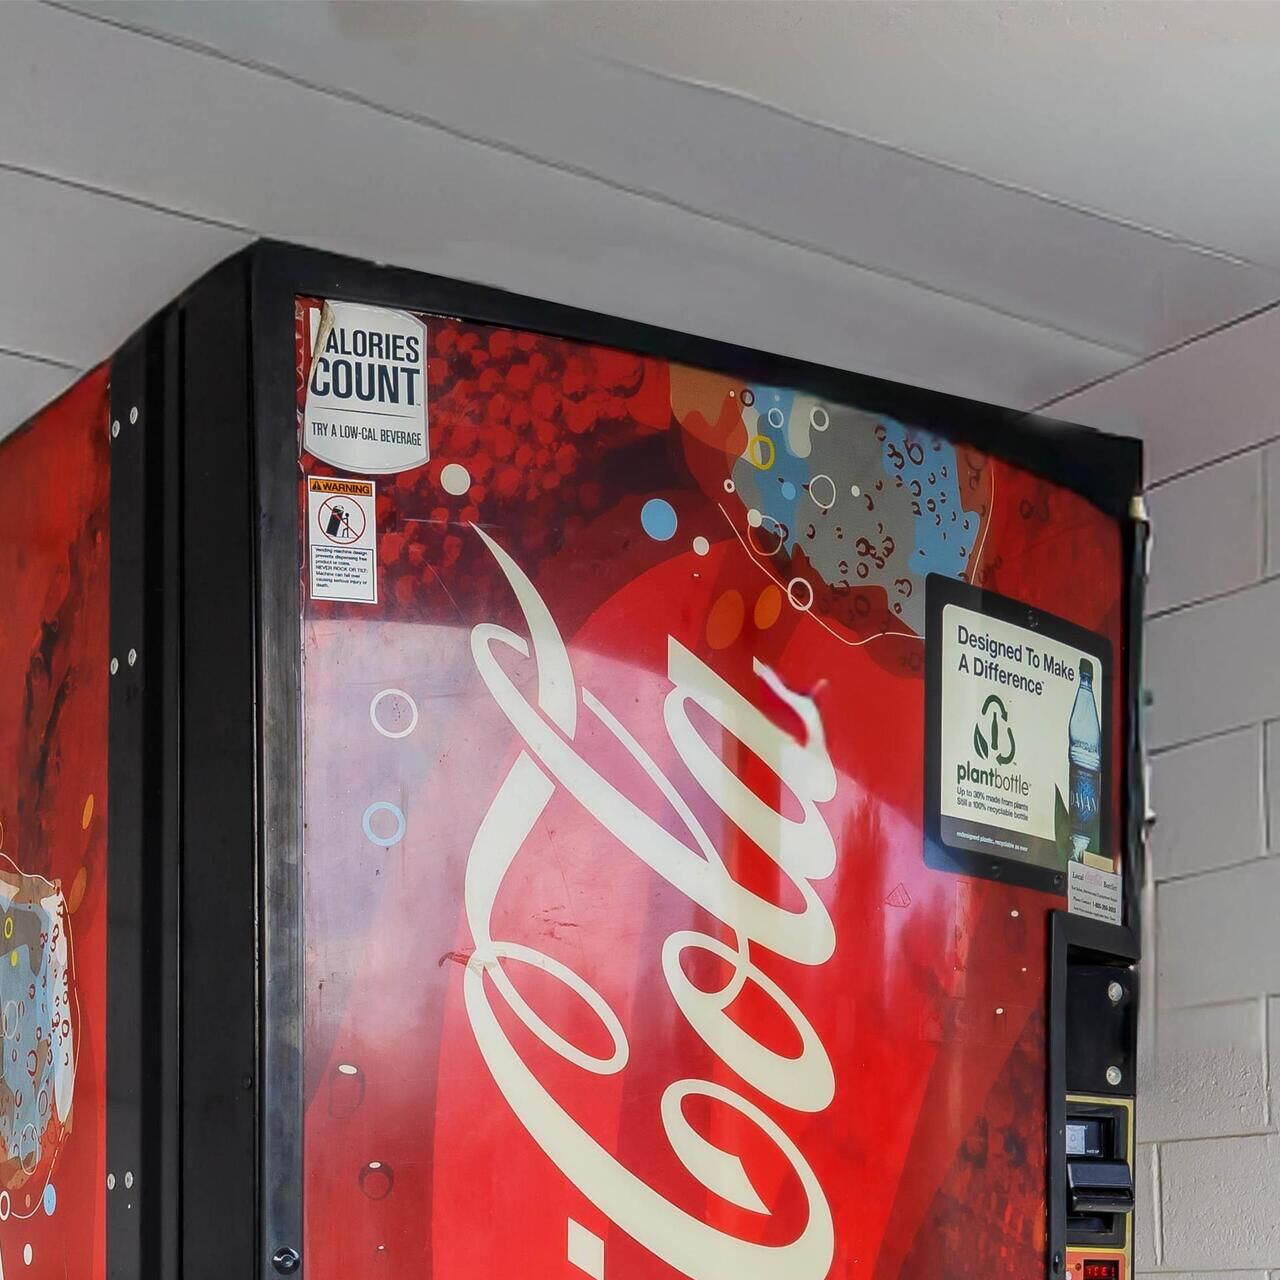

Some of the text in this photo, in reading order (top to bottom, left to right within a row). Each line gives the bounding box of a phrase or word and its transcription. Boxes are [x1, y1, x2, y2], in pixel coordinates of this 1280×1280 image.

[325, 327, 420, 364] ALORIES
[310, 356, 420, 406] COUNT
[312, 422, 422, 446] TRY A LOW-CAL BEVERAGE
[322, 482, 370, 494] WARNING
[958, 624, 1074, 682] Designed To Make
[958, 653, 1042, 696] A Difference
[957, 760, 1029, 796] plantbottle
[957, 786, 965, 796] Up
[973, 790, 984, 800] 30%
[986, 795, 1000, 803] made
[973, 801, 986, 811] 100%
